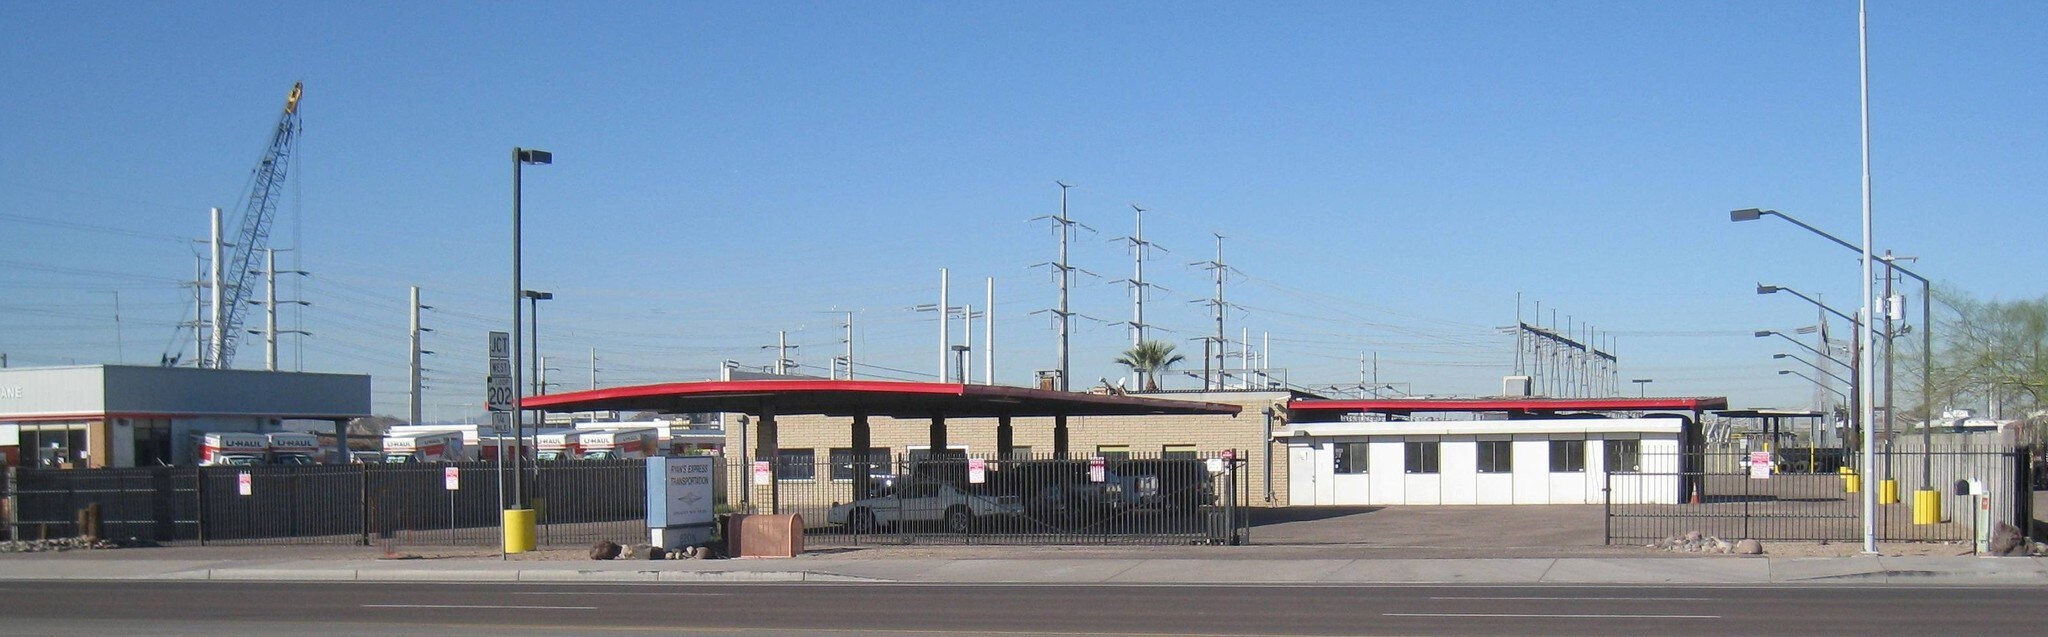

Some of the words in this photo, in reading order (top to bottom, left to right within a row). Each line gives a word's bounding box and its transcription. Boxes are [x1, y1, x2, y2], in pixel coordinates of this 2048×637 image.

[491, 338, 507, 352] JCT
[492, 363, 507, 373] WEST
[489, 387, 512, 405] 202
[277, 439, 312, 447] U-HAUL
[671, 465, 687, 473] RYAN'S
[687, 464, 708, 473] EXPRESS
[671, 476, 709, 485] TRANSPORTATION
